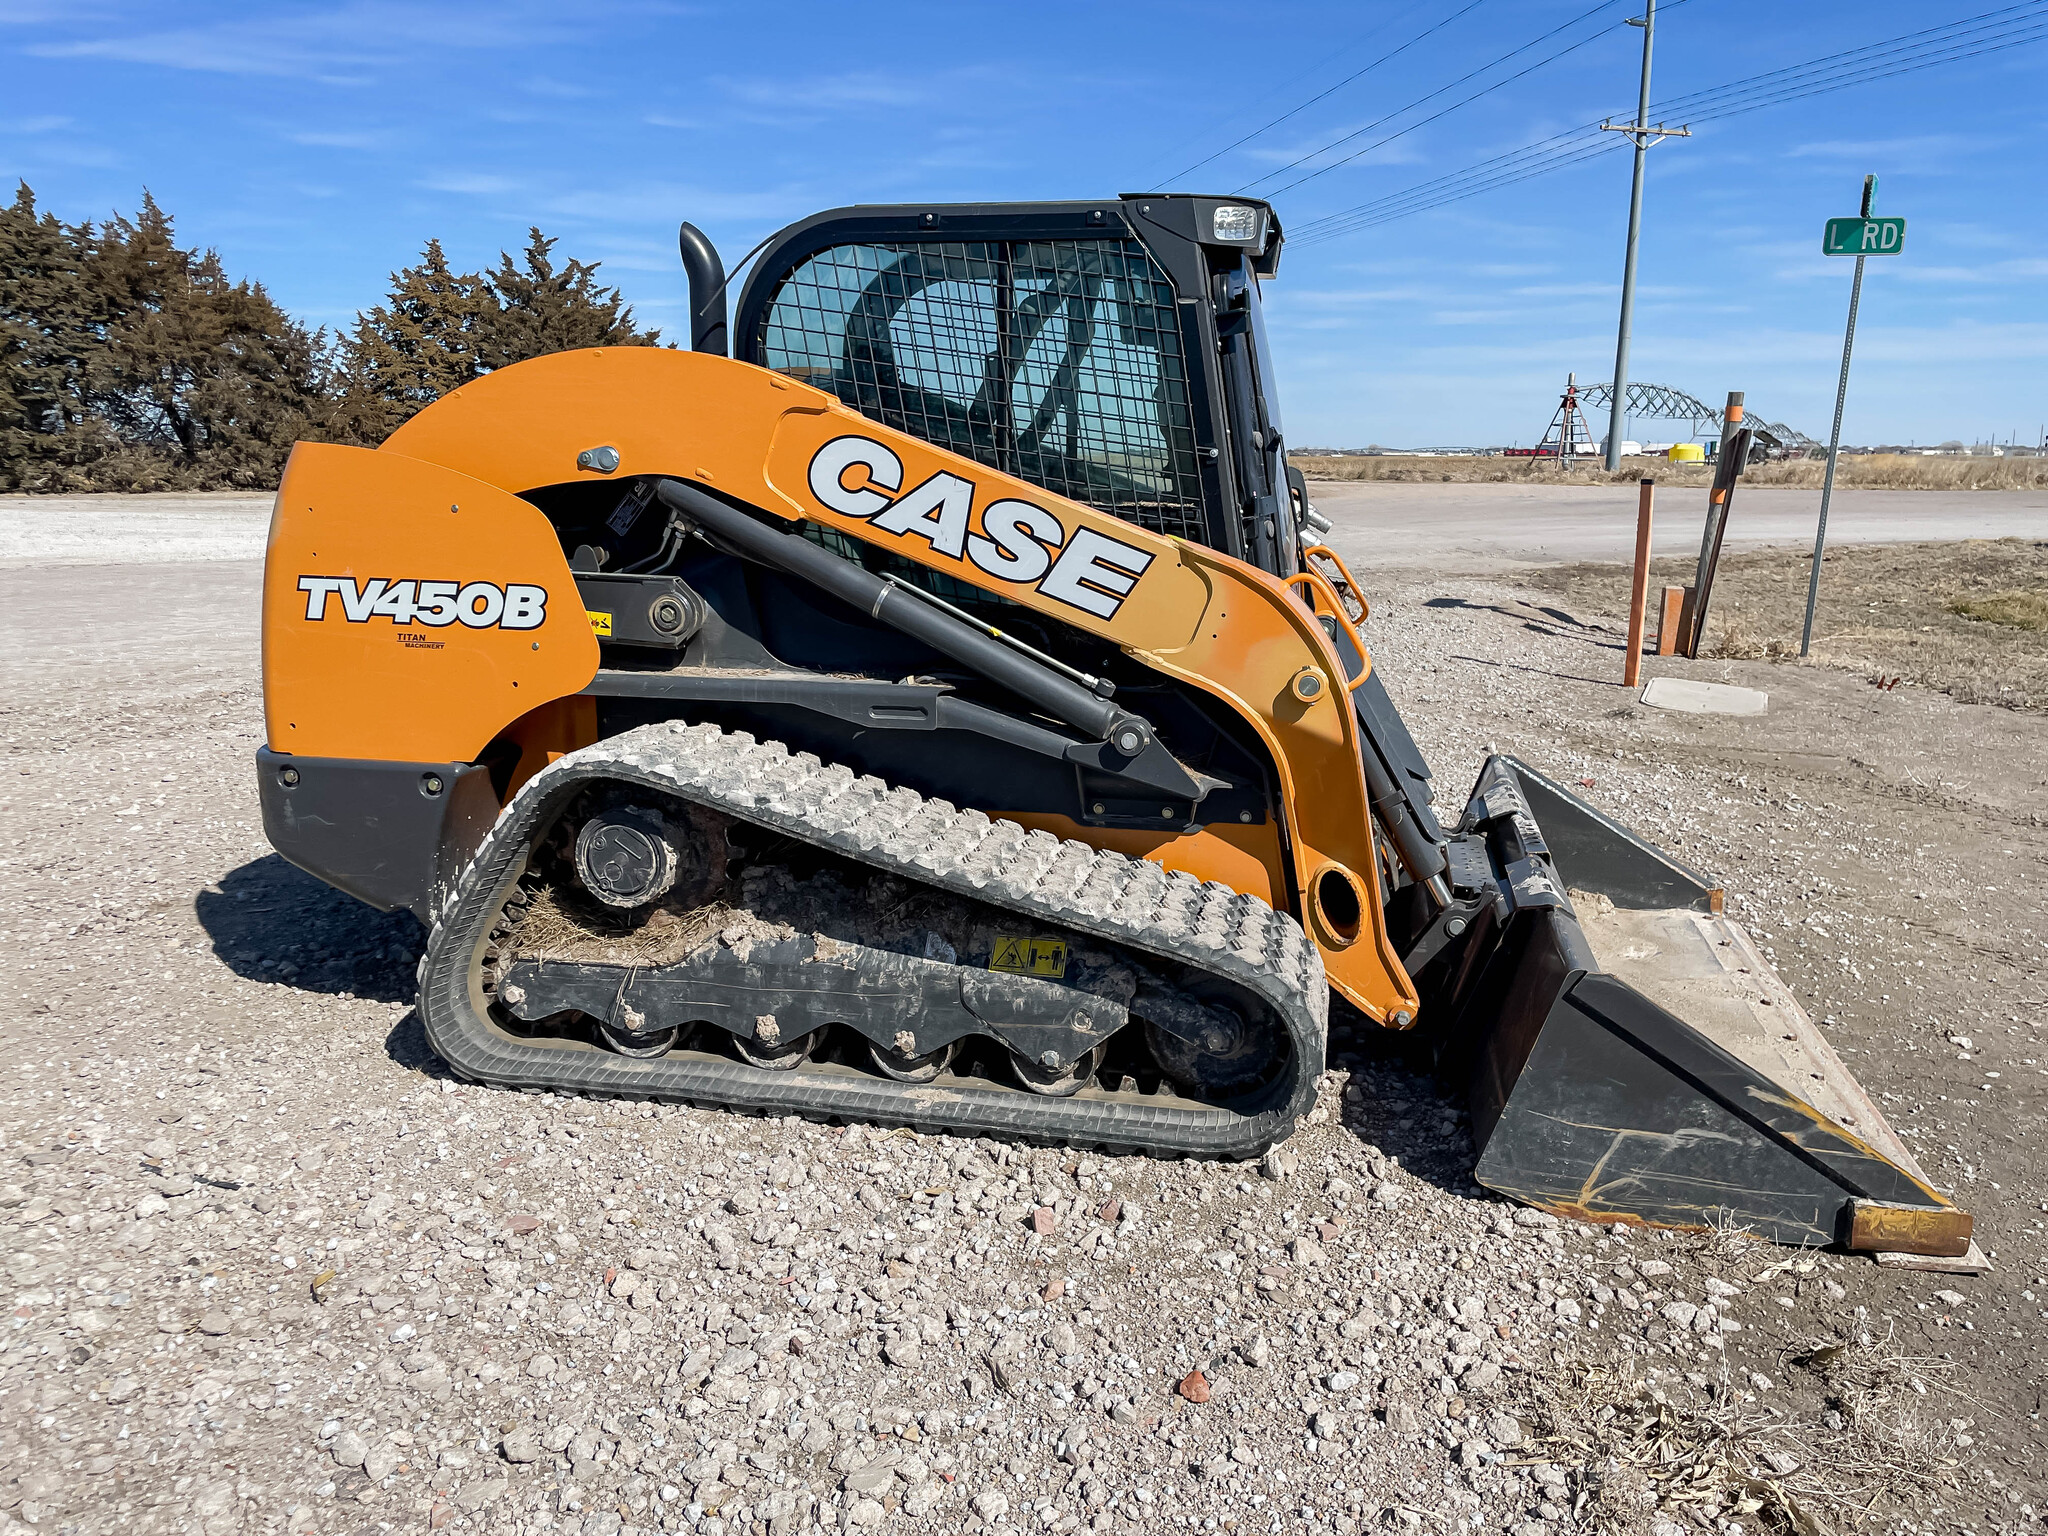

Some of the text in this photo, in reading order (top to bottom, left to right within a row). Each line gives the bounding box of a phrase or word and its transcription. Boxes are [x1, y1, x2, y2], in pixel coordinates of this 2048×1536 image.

[1829, 223, 1898, 249] L RD
[808, 435, 1156, 621] CASE
[297, 575, 547, 630] TV450B
[397, 633, 426, 641] TITAN
